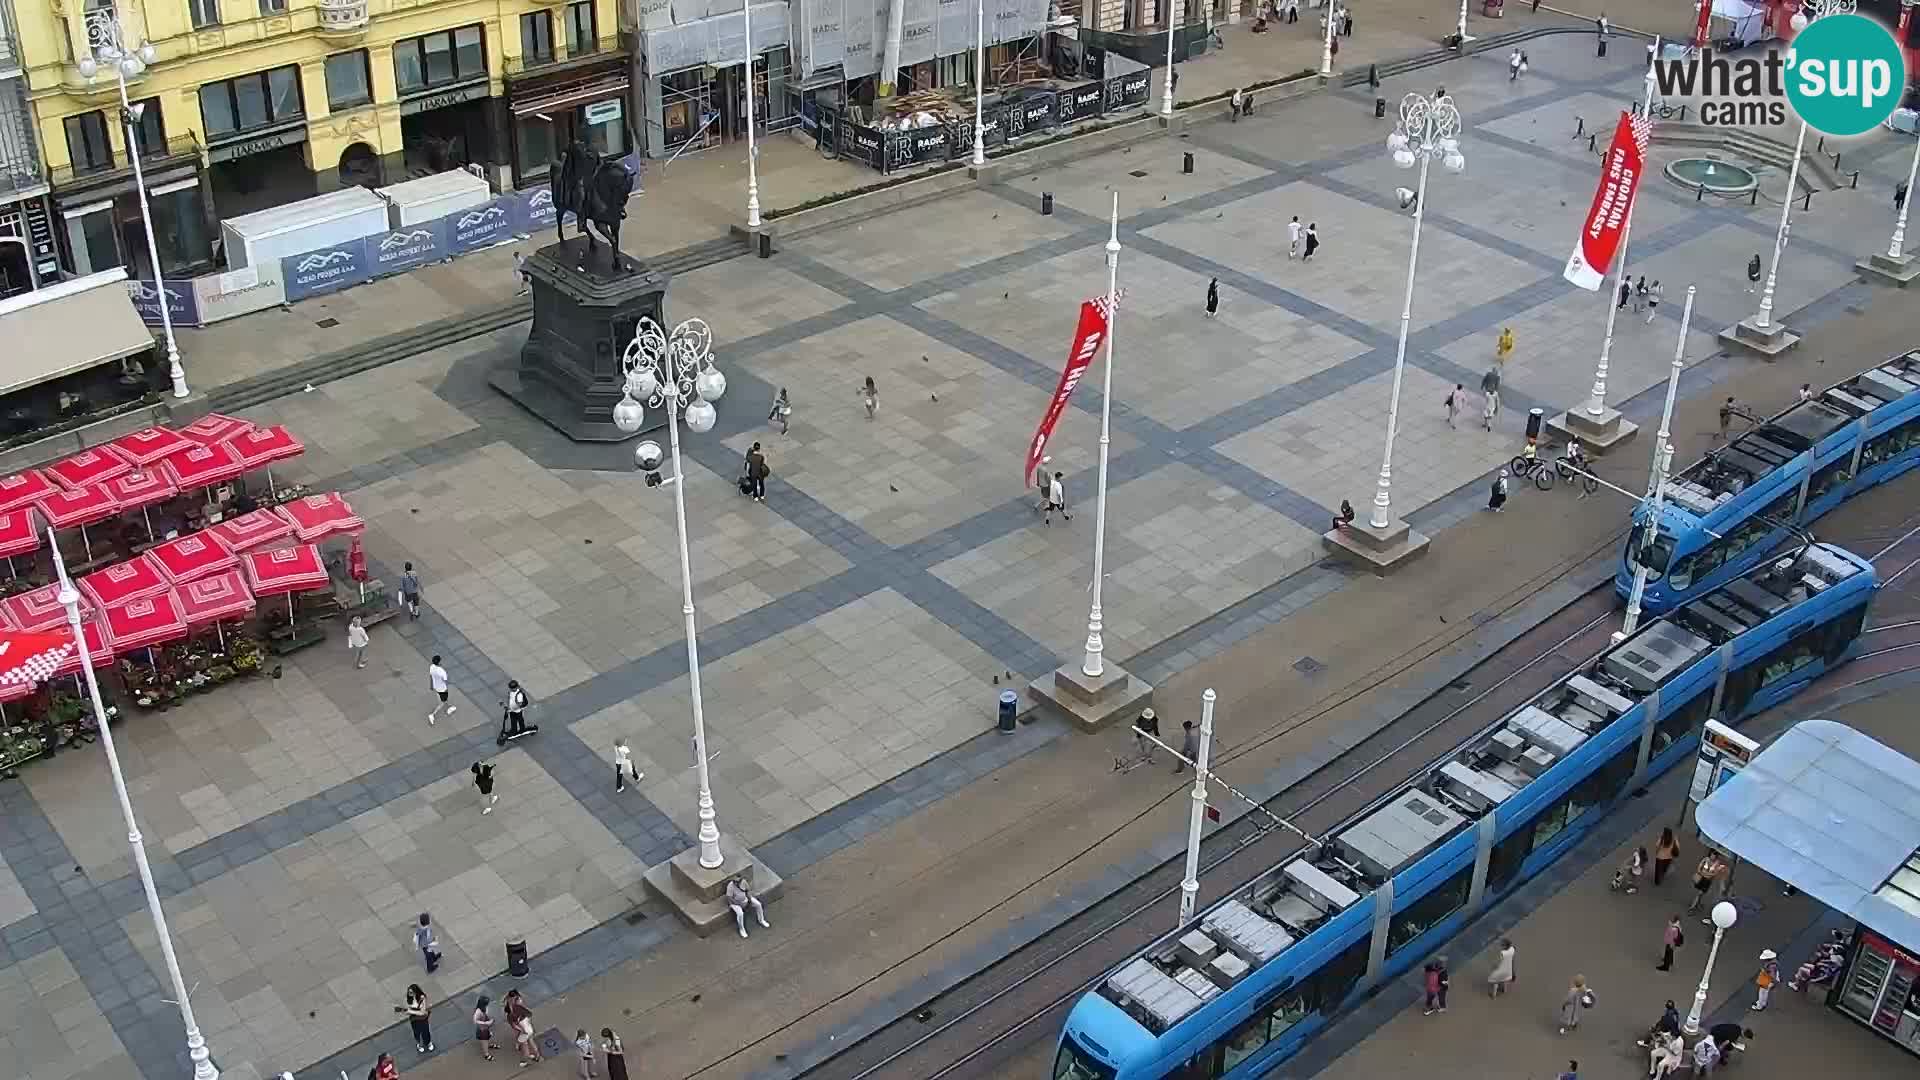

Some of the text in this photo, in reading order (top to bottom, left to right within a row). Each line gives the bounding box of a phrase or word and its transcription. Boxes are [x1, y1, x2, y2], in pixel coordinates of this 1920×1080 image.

[1589, 147, 1625, 240] FANS EMBASSY
[1606, 167, 1633, 230] CROATIAN
